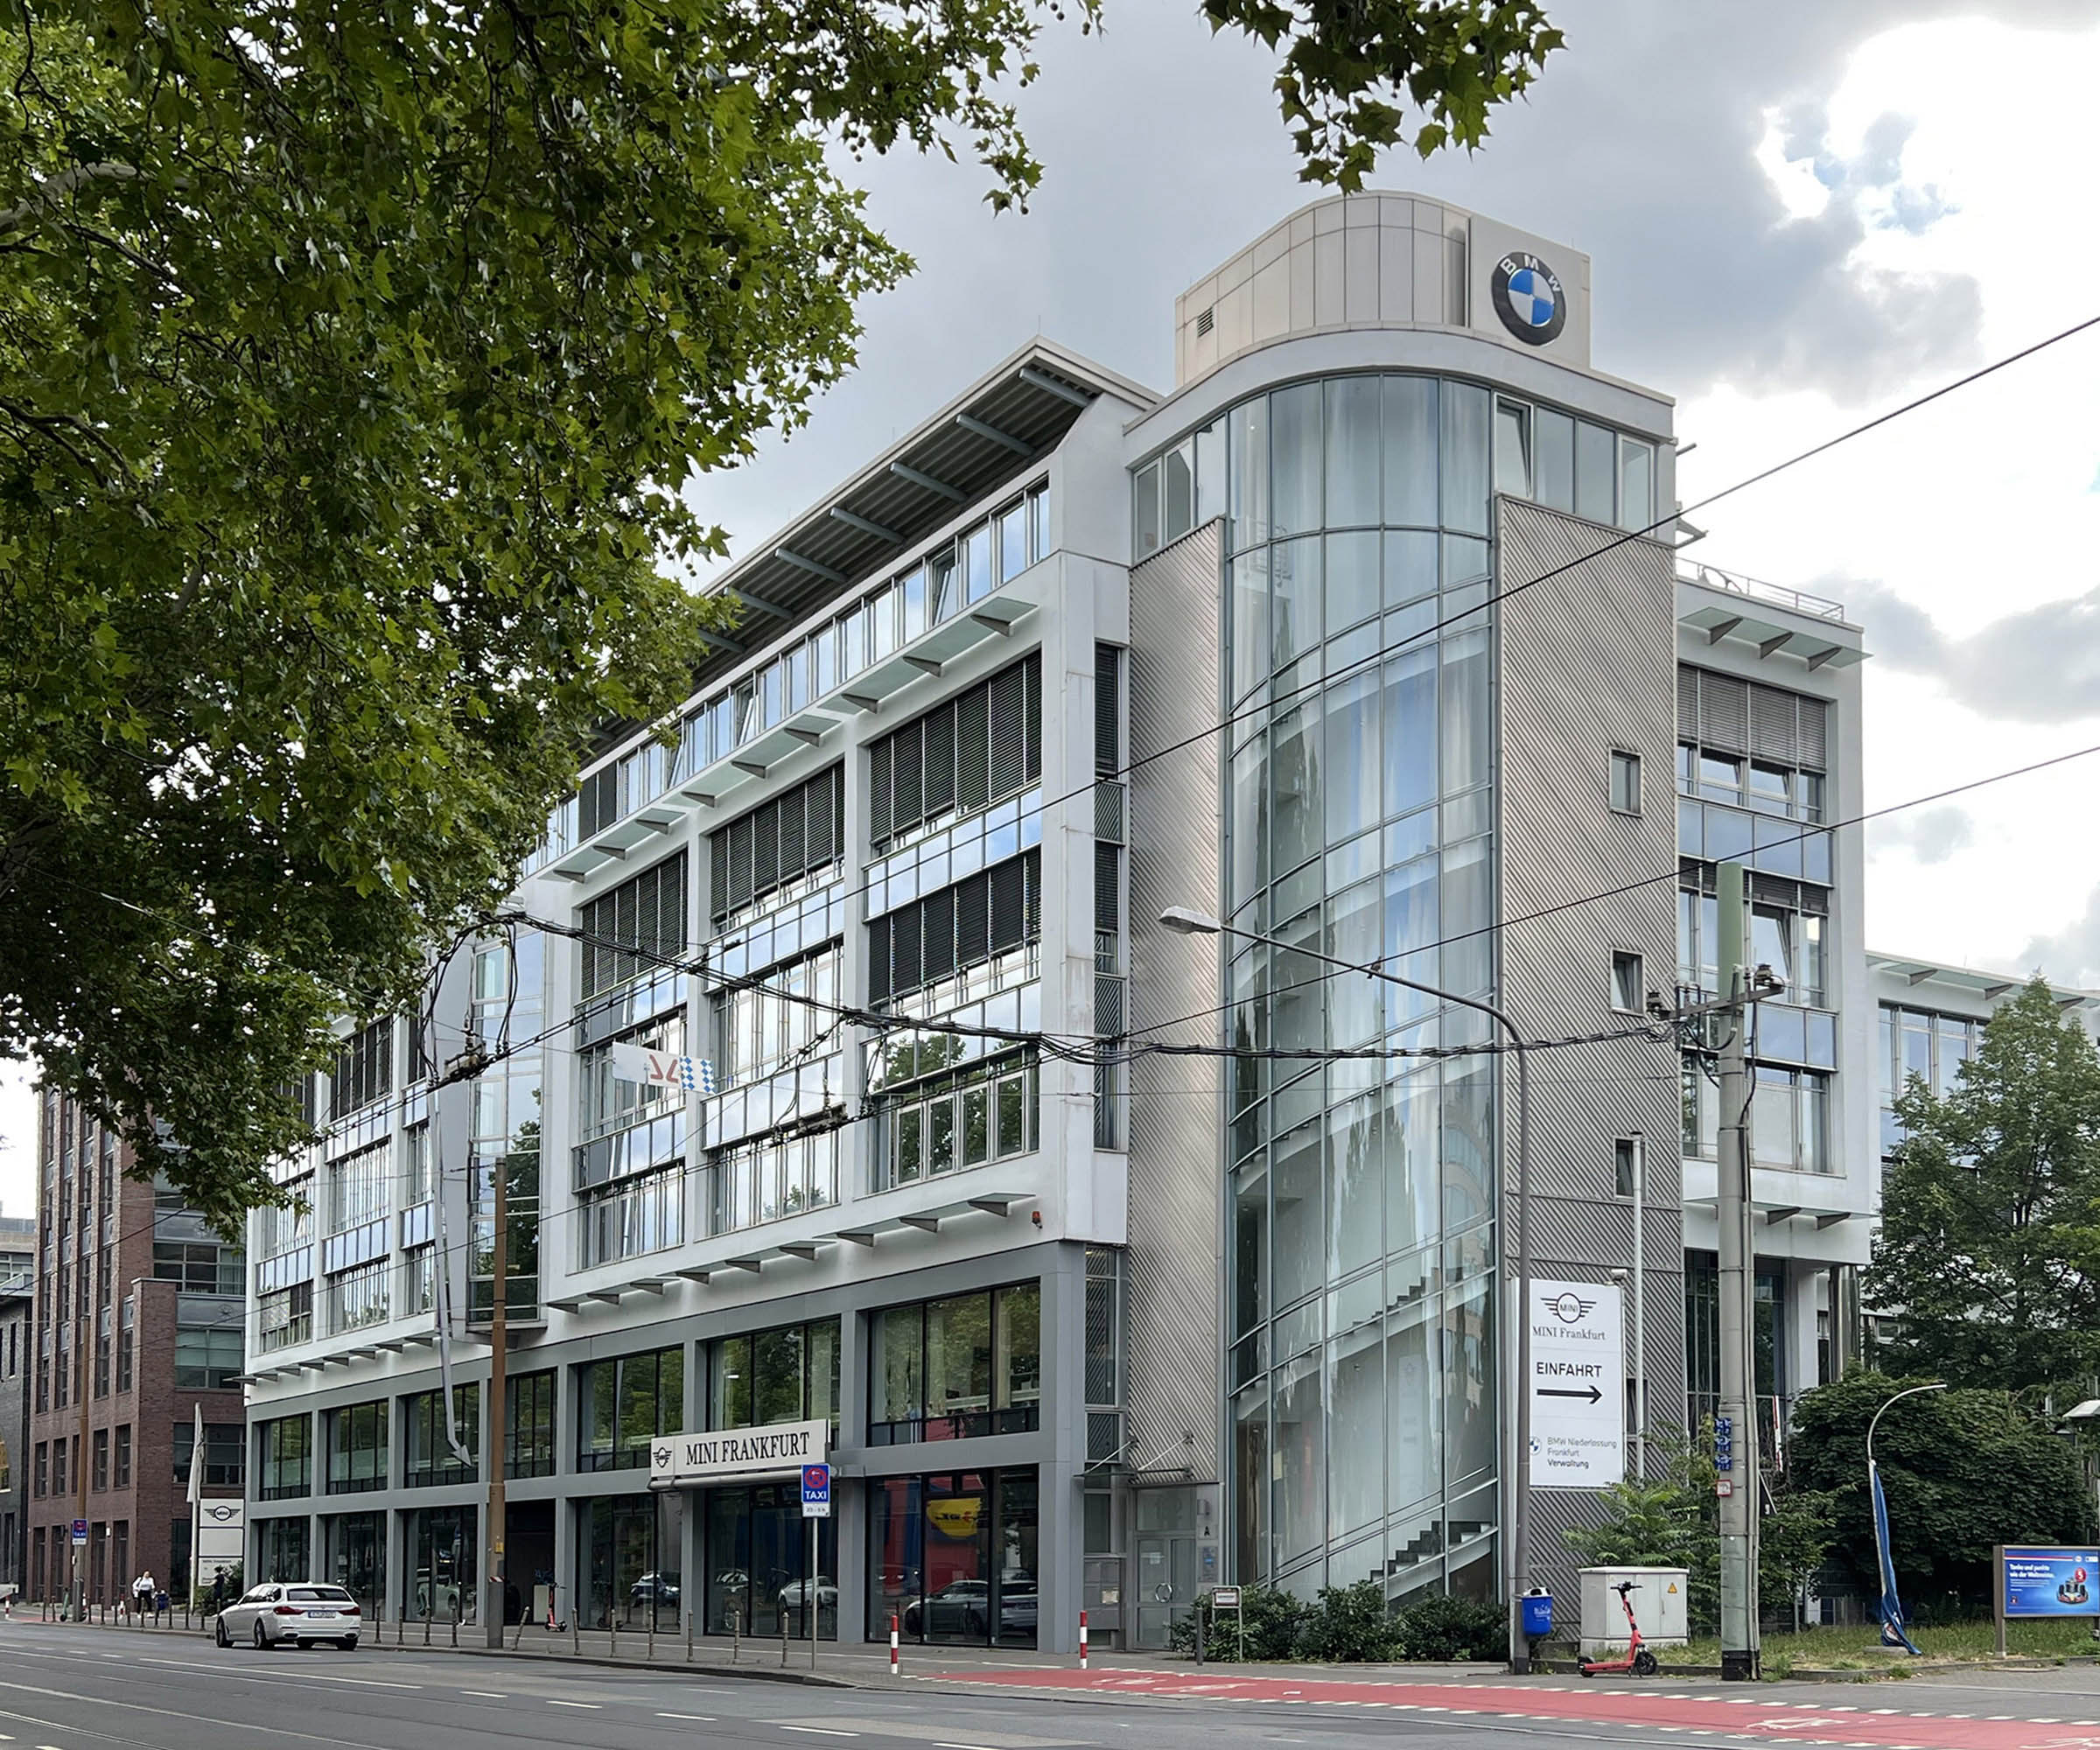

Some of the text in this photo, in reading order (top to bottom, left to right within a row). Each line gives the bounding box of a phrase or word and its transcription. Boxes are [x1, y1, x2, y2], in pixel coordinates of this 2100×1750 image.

[1500, 254, 1562, 292] BMW
[1559, 1304, 1578, 1312] MINI
[1532, 1326, 1606, 1340] MINI Frankfurt
[1536, 1362, 1602, 1377] EINFAHRT
[1547, 1437, 1617, 1449] BMW Niederlassung
[686, 1432, 810, 1466] MINI FRANKFURT
[1547, 1448, 1580, 1457] Frankfurt
[1547, 1459, 1589, 1469] Verwaltung
[805, 1490, 827, 1500] TAXI
[1203, 1525, 1210, 1536] A
